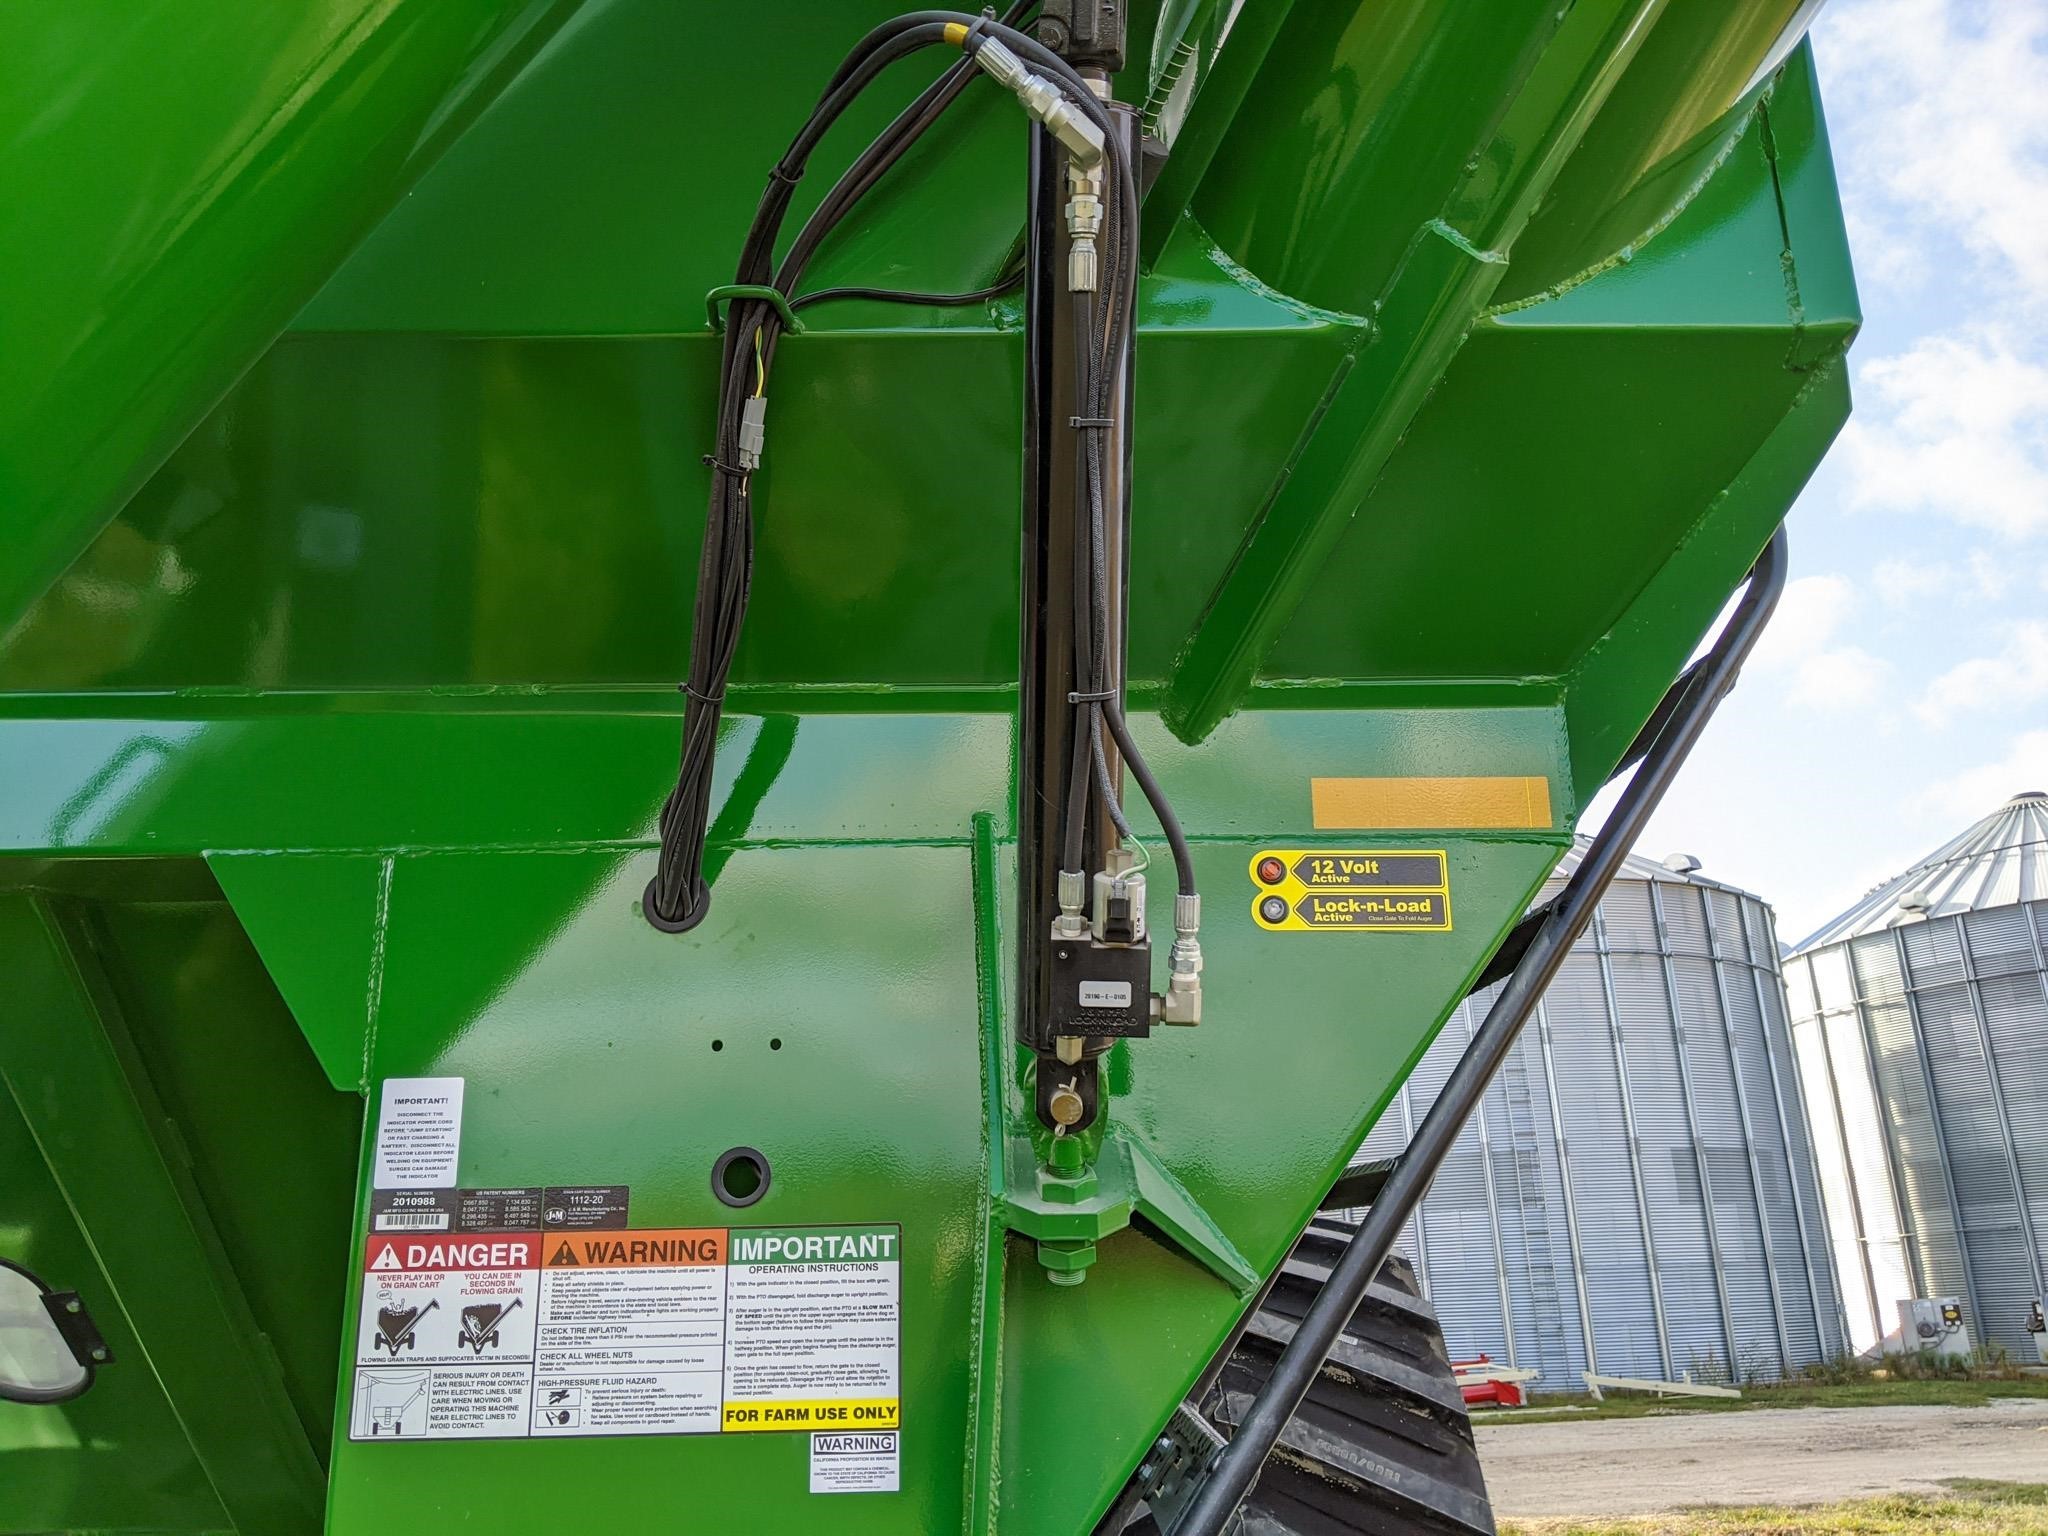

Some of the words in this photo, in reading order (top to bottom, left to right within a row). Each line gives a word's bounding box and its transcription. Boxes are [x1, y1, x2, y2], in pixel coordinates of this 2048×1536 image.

[1312, 860, 1335, 873] 12
[1340, 860, 1379, 873] Volt
[1314, 899, 1431, 912] Lock-n-Load
[1314, 913, 1353, 921] Active
[393, 1198, 435, 1206] 2010988
[571, 1196, 603, 1204] 1112-20
[585, 1239, 717, 1263] WARNING
[734, 1234, 895, 1260] IMPORTANT
[408, 1243, 528, 1268] DANGER
[749, 1265, 805, 1274] OPERATING
[808, 1263, 878, 1272] INSTRUCTIONS
[726, 1410, 758, 1422] FOR
[764, 1409, 809, 1421] FARM
[815, 1408, 847, 1420] USE
[853, 1407, 896, 1419] ONLY
[818, 1437, 891, 1450] WARNING
